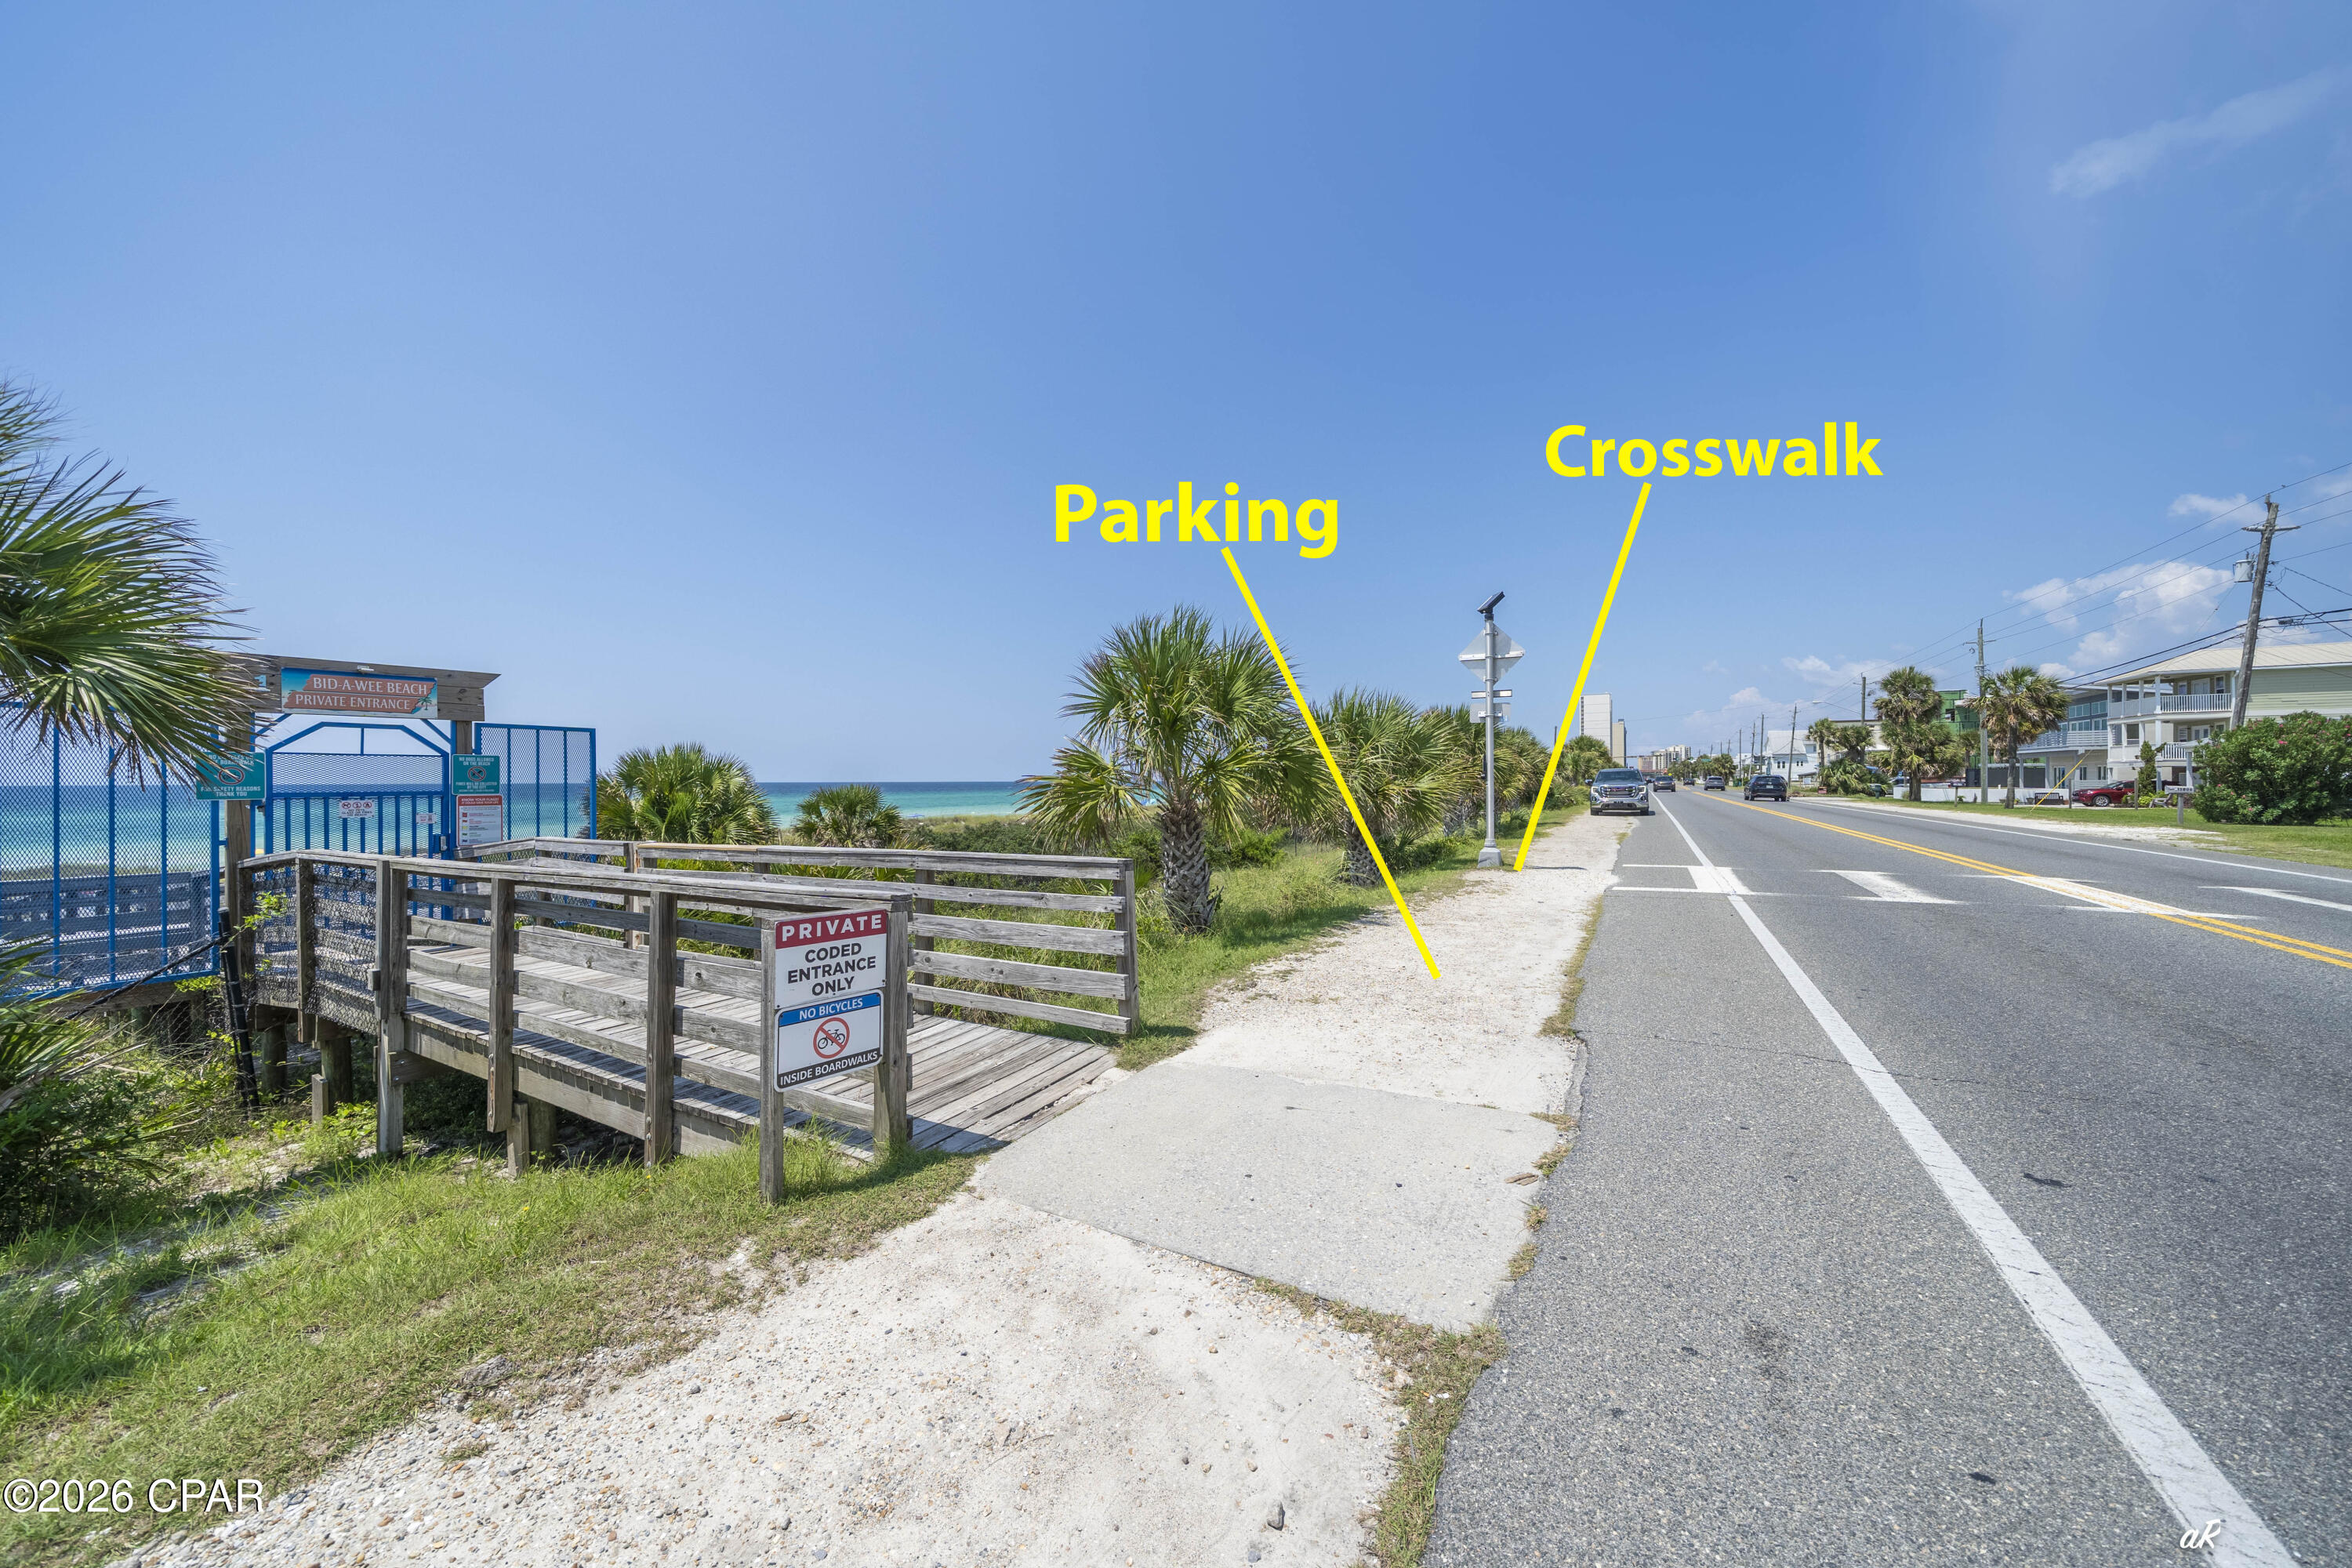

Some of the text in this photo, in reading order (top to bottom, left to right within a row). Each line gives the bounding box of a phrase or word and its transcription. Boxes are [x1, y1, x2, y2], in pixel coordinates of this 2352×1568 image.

[314, 677, 427, 695] BID-A-WEE BEACH
[296, 694, 410, 710] PRIVATE ENTRANCE
[782, 914, 883, 942] PRIVATE
[804, 942, 862, 963] CODED
[787, 956, 877, 984] ENTRANCE
[811, 976, 855, 996] ONLY
[799, 998, 863, 1021] NO BICYCLES
[780, 1051, 878, 1086] INSIDE BOARDWALKS
